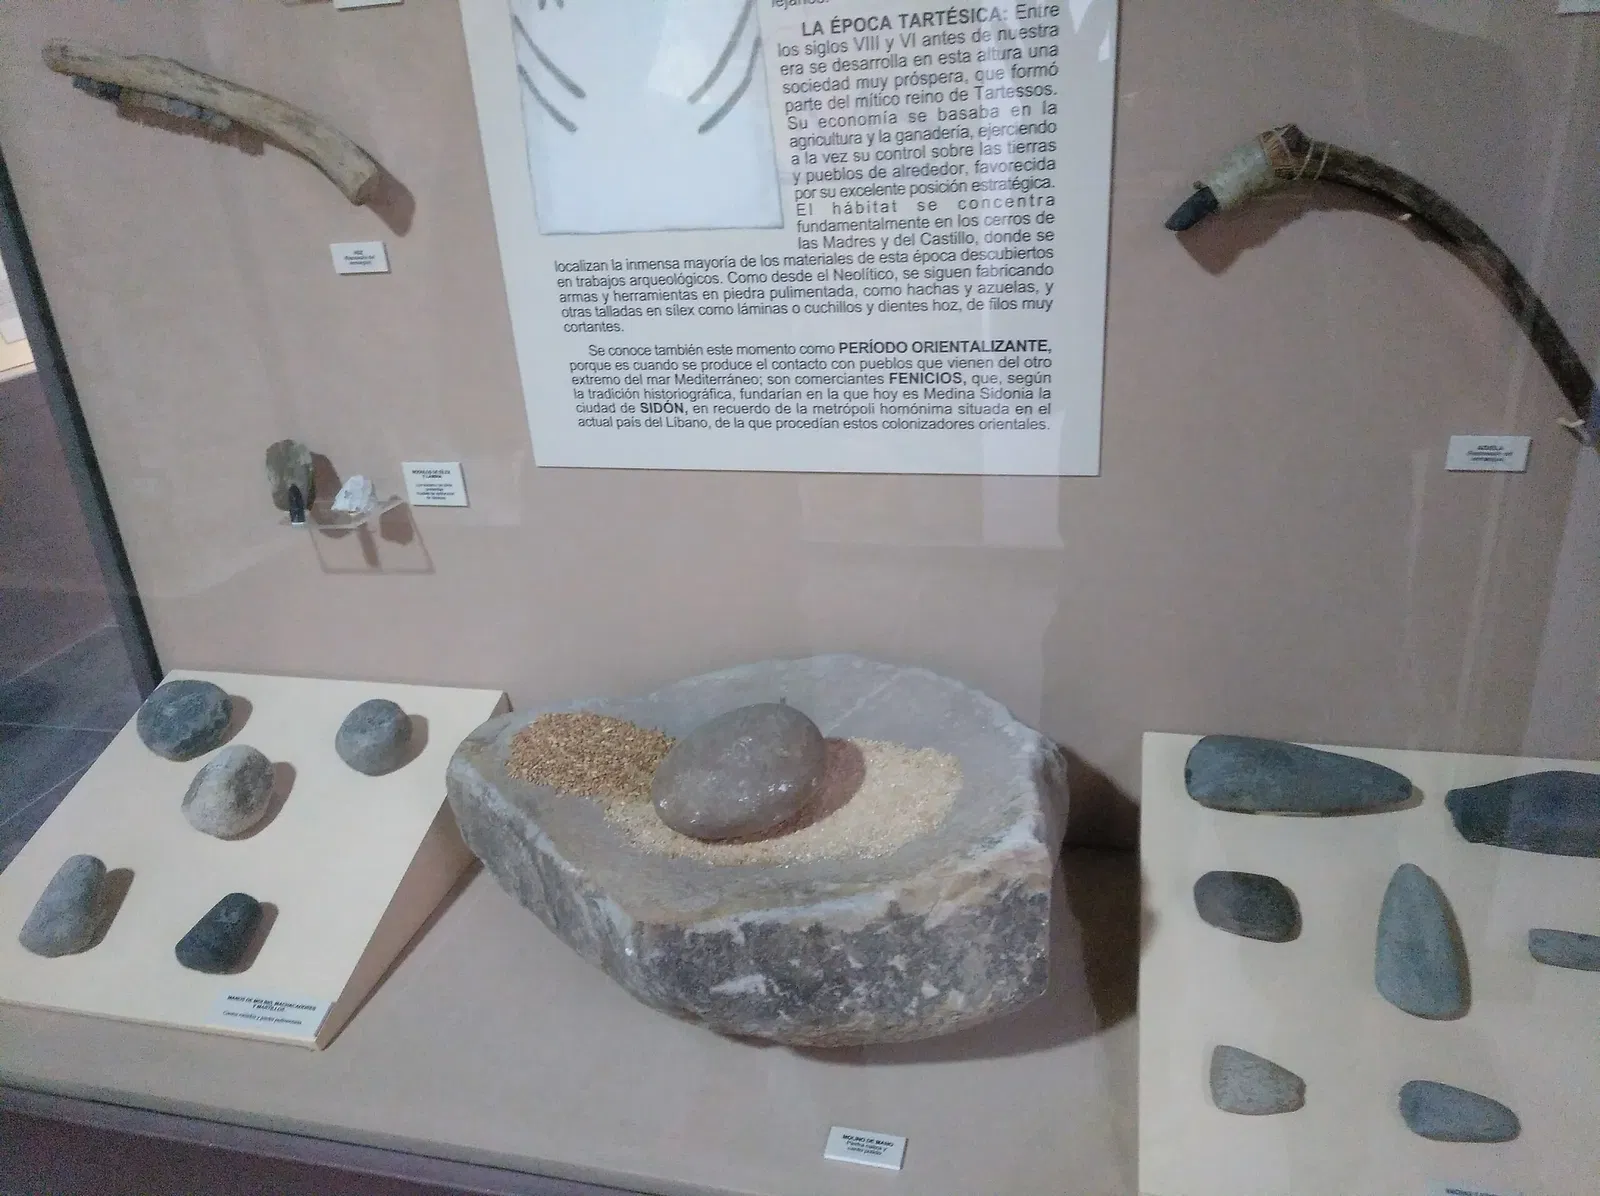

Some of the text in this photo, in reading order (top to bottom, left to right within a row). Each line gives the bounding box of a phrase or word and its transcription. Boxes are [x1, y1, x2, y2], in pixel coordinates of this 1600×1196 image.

[802, 4, 1060, 36] LA ÉPOCA TARTÉSICA: Entre
[778, 23, 1060, 59] los siglos VIII y VI antes de nuestra
[780, 46, 1059, 76] era se desarrolla en esta altura una
[782, 63, 1059, 94] sociedad muy próspera, que formó
[785, 82, 1058, 115] parte del mítico reino de Tartessos.
[788, 102, 1058, 129] Su economía se basaba en la
[789, 120, 1058, 150] agricultura y la ganadería, ejerciendo
[791, 139, 1057, 165] a la vez su control sobre las tierras
[792, 157, 1056, 186] y pueblos de alrededor, favorecida
[794, 175, 1055, 202] por su excelente posición estratégica.
[796, 193, 1055, 216] El hábitat se concentra
[796, 211, 1055, 232] fundamentalmente en los cerros de
[798, 230, 1055, 250] las Madres y del Castillo, donde se
[554, 247, 1054, 272] localizan la inmensa mayoría de los materiales de esta época descubiertos
[557, 264, 1054, 290] en trabajos arqueológicos. Como desde el Neolítico, se siguen fabricando
[559, 282, 1055, 304] armas y herramientas en piedra pulimentada, como hachas y azuelas, y
[564, 320, 624, 333] cortantes.
[588, 339, 1052, 356] Se conoce también este momento como PERÍODO ORIENTALIZANTE,
[572, 371, 1052, 387] extremo del mar Mediterráneo; son comerciantes FENICIOS, que, según
[578, 416, 1050, 432] actual país del Líbano, de la que procedían estos colonizadores orientales.
